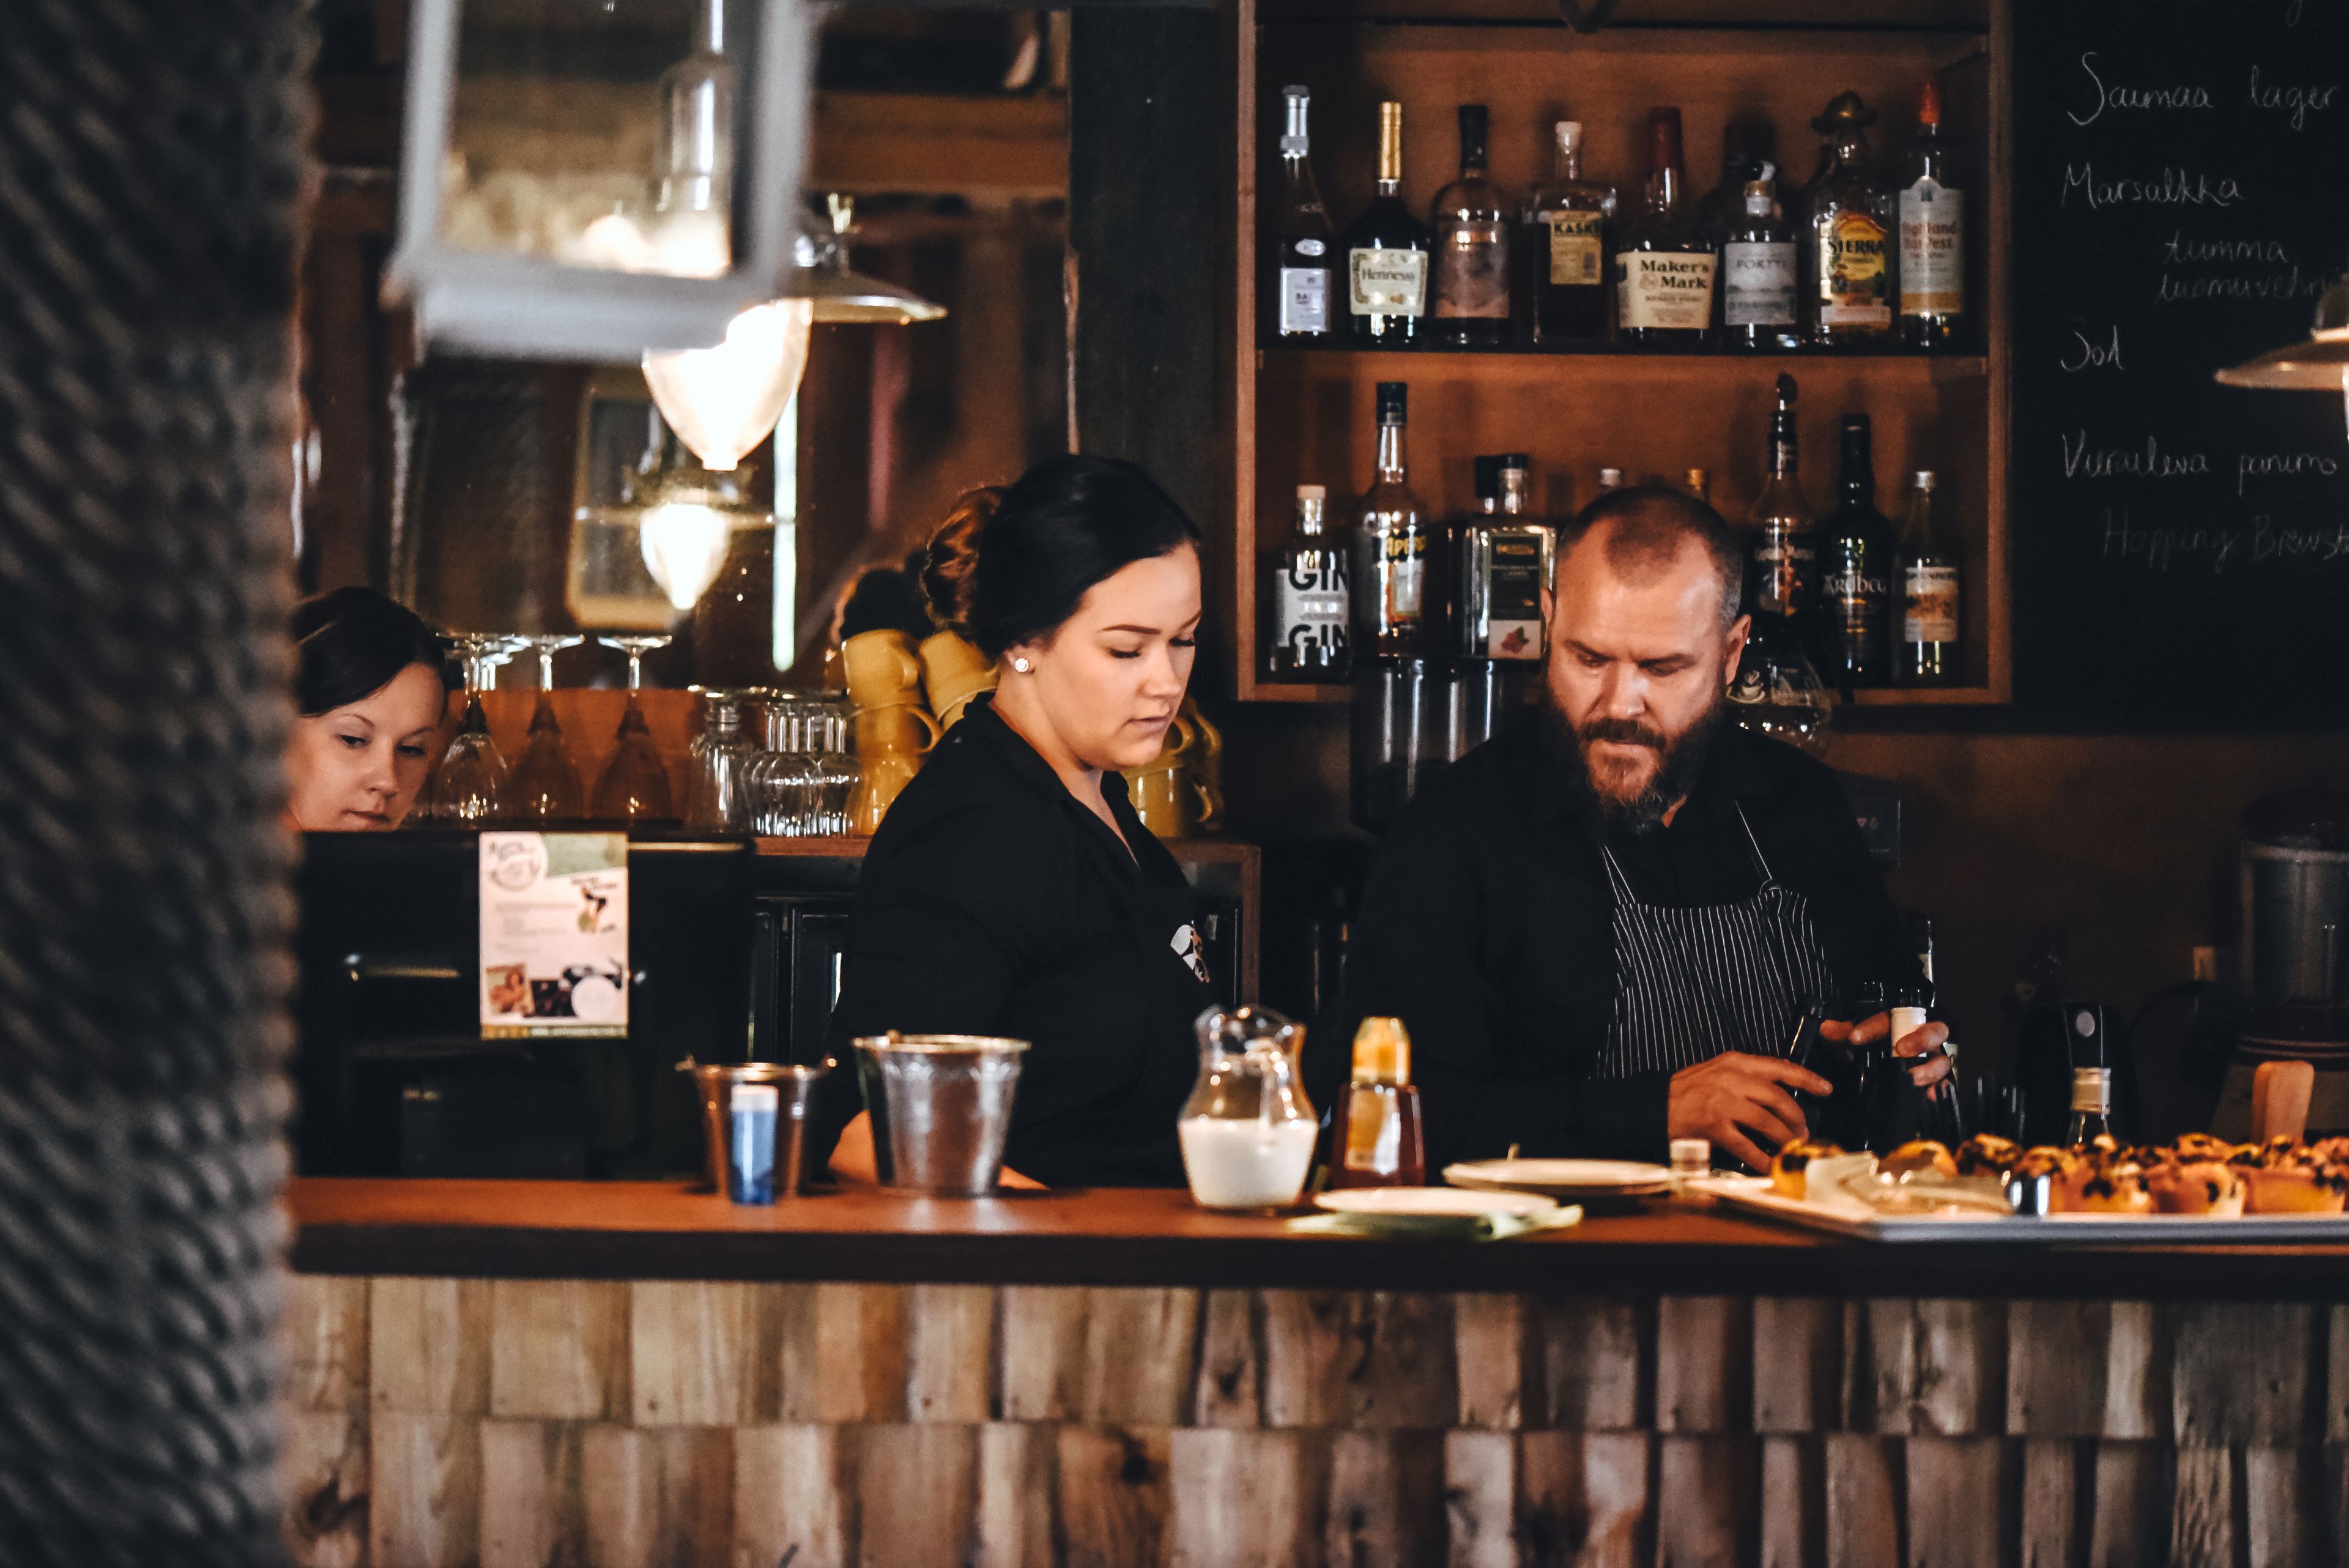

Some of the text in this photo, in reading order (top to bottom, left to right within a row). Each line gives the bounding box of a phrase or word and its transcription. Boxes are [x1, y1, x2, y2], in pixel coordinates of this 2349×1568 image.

[2249, 64, 2340, 131] lager
[2060, 161, 2244, 209] Marsalkka
[1640, 259, 1709, 273] Maker's
[2165, 230, 2288, 264] tumma
[1661, 275, 1708, 289] Mark
[2157, 265, 2328, 301] luomuvehn
[2238, 453, 2339, 498] panimo
[2096, 505, 2241, 574] Hopping
